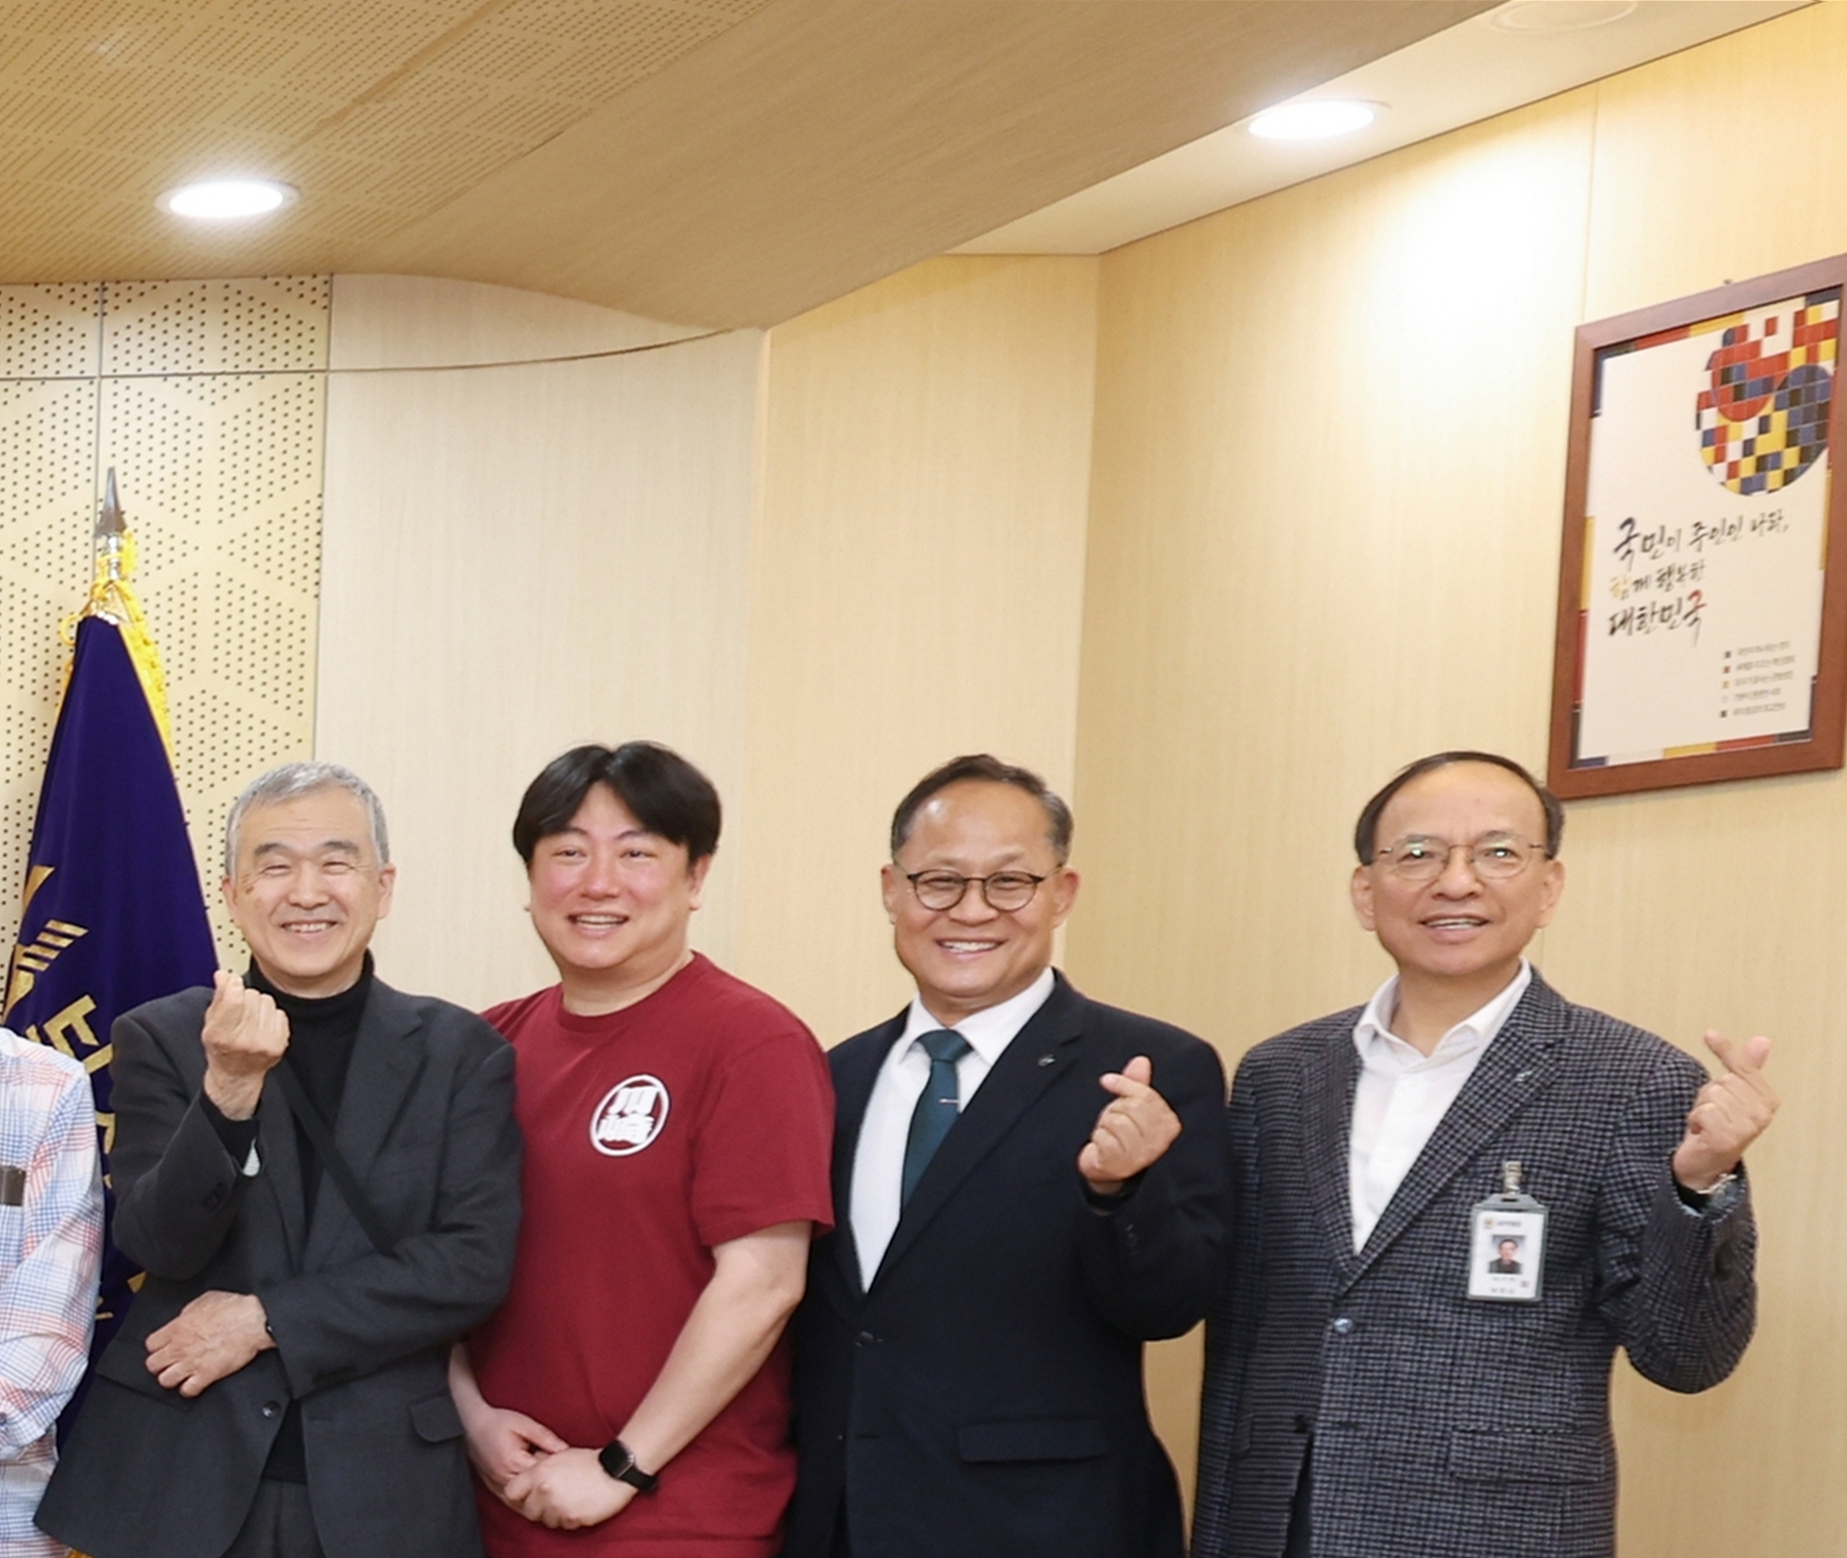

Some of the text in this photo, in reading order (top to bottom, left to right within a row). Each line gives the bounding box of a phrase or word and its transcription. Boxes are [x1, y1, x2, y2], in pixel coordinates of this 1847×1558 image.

[1612, 515, 1683, 573] 국민이
[1687, 514, 1744, 553] 주인인
[1608, 588, 1708, 648] 대한민국
